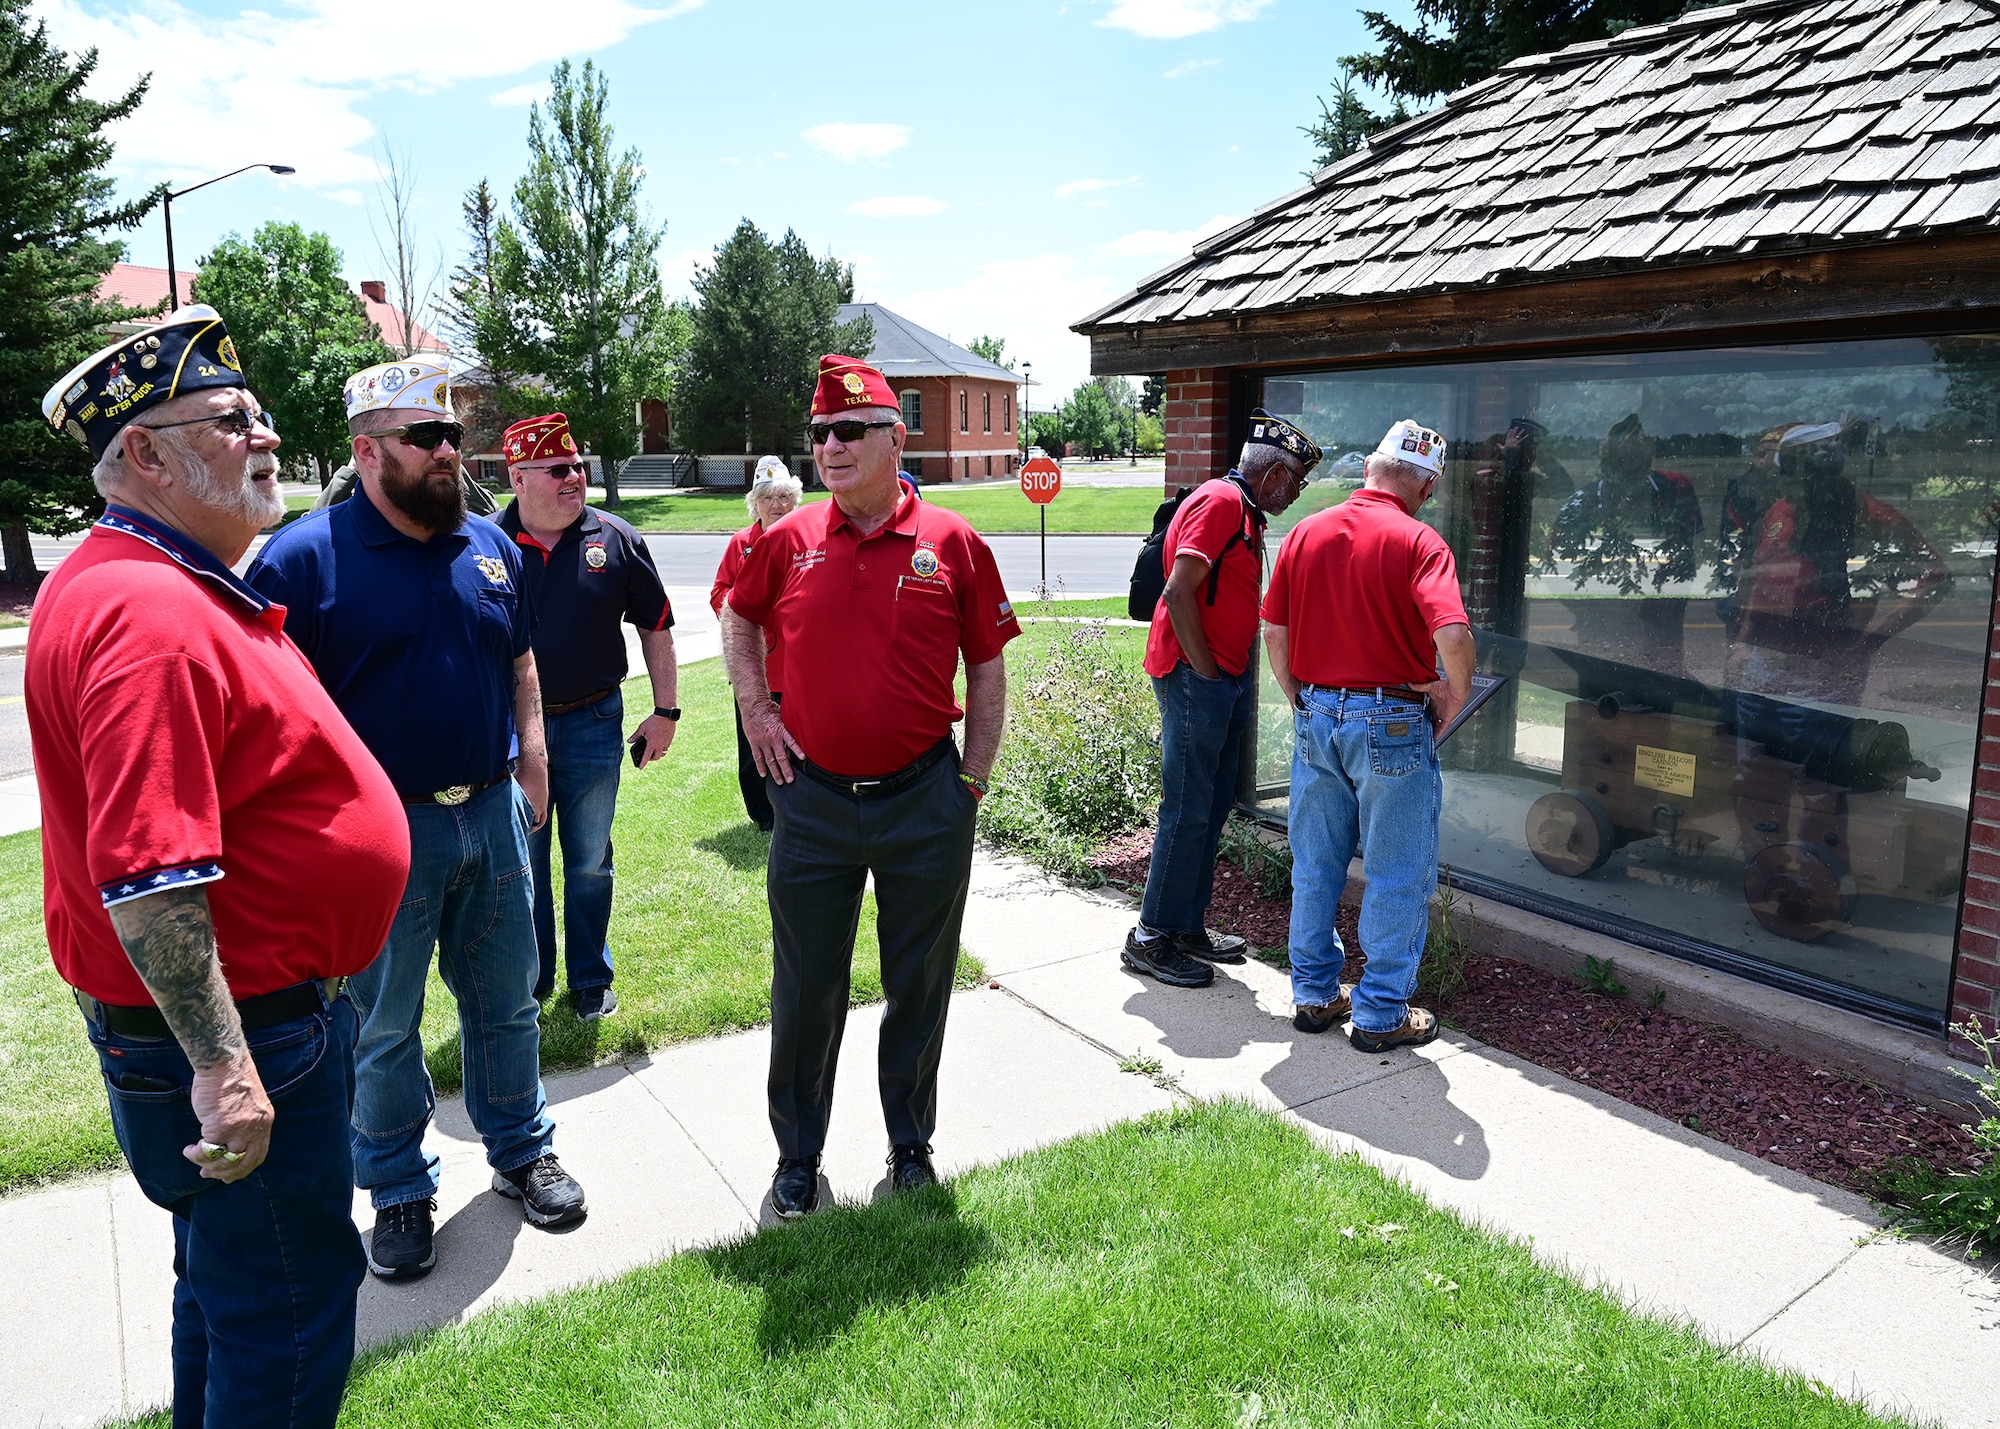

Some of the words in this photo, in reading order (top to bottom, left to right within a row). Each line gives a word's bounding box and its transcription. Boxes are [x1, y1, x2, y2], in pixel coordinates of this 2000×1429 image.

[198, 365, 219, 377] 24
[131, 381, 155, 404] BUCK
[414, 397, 427, 405] 28
[844, 394, 872, 406] TEXAS
[543, 448, 554, 456] 24
[1023, 471, 1058, 490] STOP
[919, 540, 935, 549] 2022
[1638, 749, 1666, 759] ENGLISH
[1668, 754, 1694, 764] FALCON
[1651, 758, 1679, 767] CANNON
